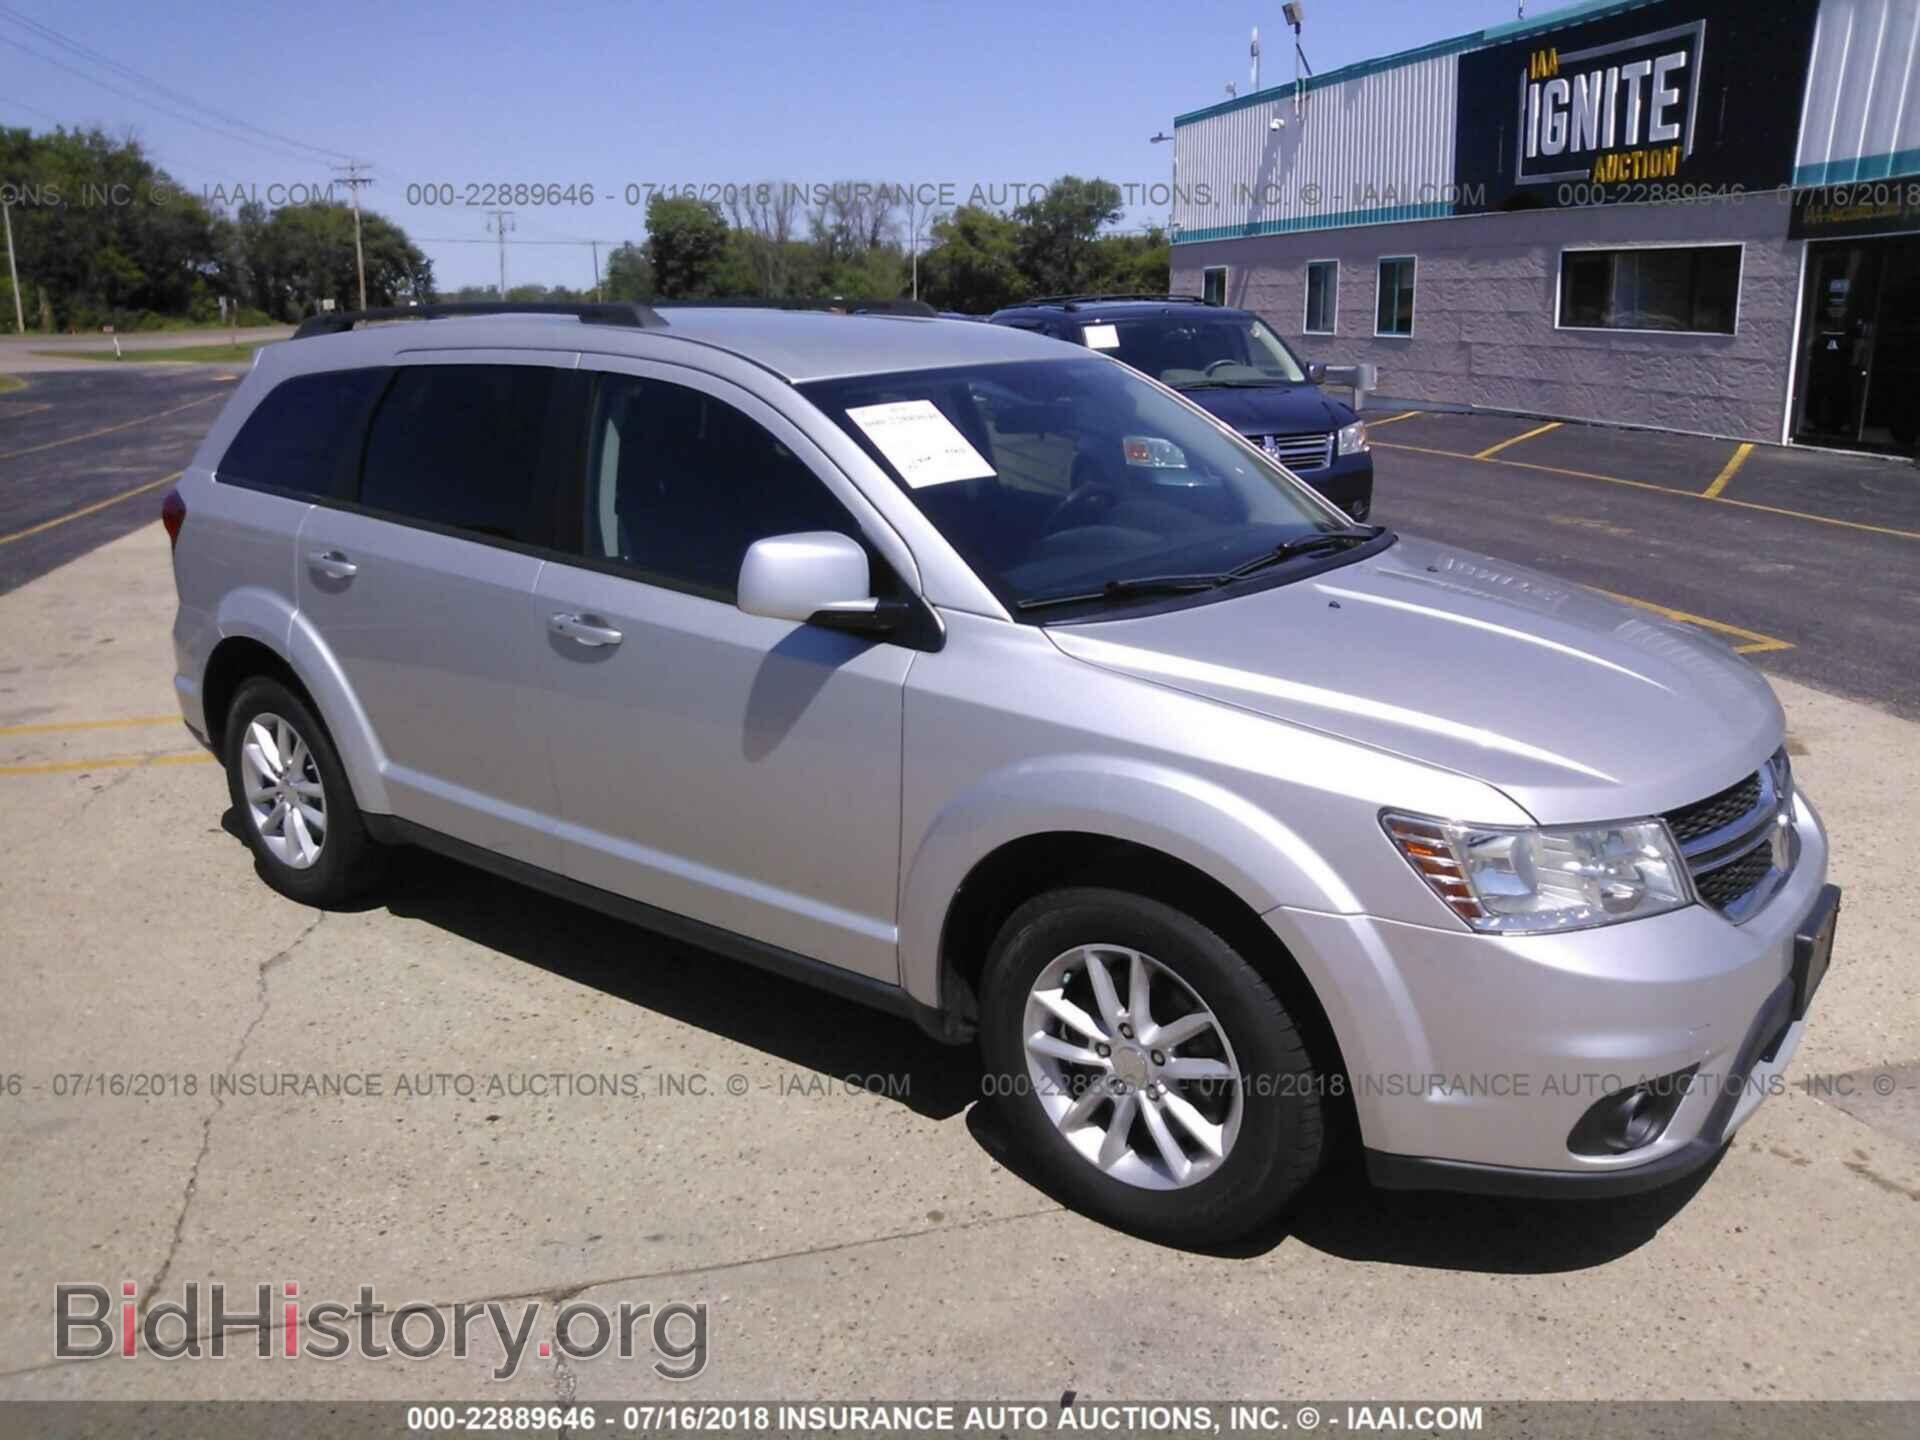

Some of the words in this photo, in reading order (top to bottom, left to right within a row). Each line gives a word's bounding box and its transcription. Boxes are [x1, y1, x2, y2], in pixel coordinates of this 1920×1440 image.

[1530, 48, 1560, 80] IAA
[1525, 51, 1688, 158] IGNITE
[1592, 145, 1682, 184] AUCTION
